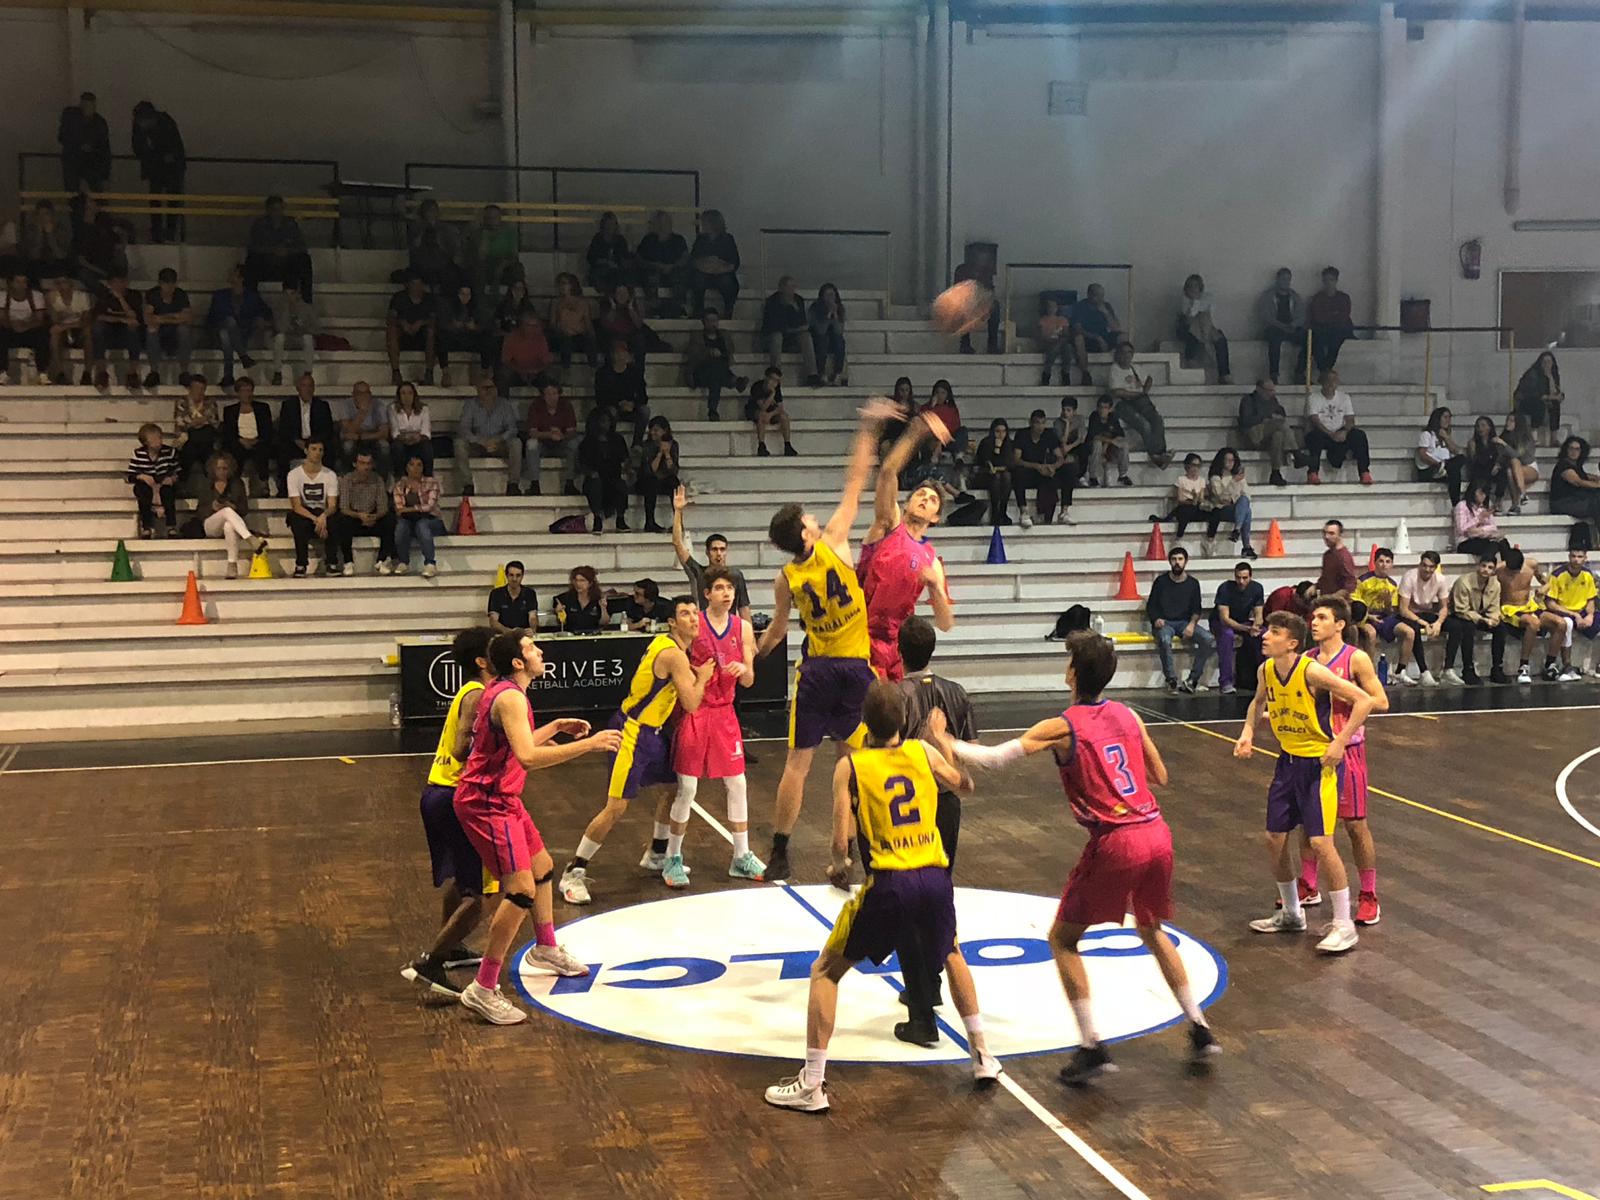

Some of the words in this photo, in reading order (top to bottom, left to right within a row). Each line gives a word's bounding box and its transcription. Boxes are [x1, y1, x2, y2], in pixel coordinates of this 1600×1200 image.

[802, 568, 853, 619] 14
[529, 679, 570, 690] ETBALL
[573, 677, 624, 688] ACADEMY
[543, 659, 623, 679] RIVE3
[1103, 743, 1137, 796] 3
[884, 774, 922, 827] 2
